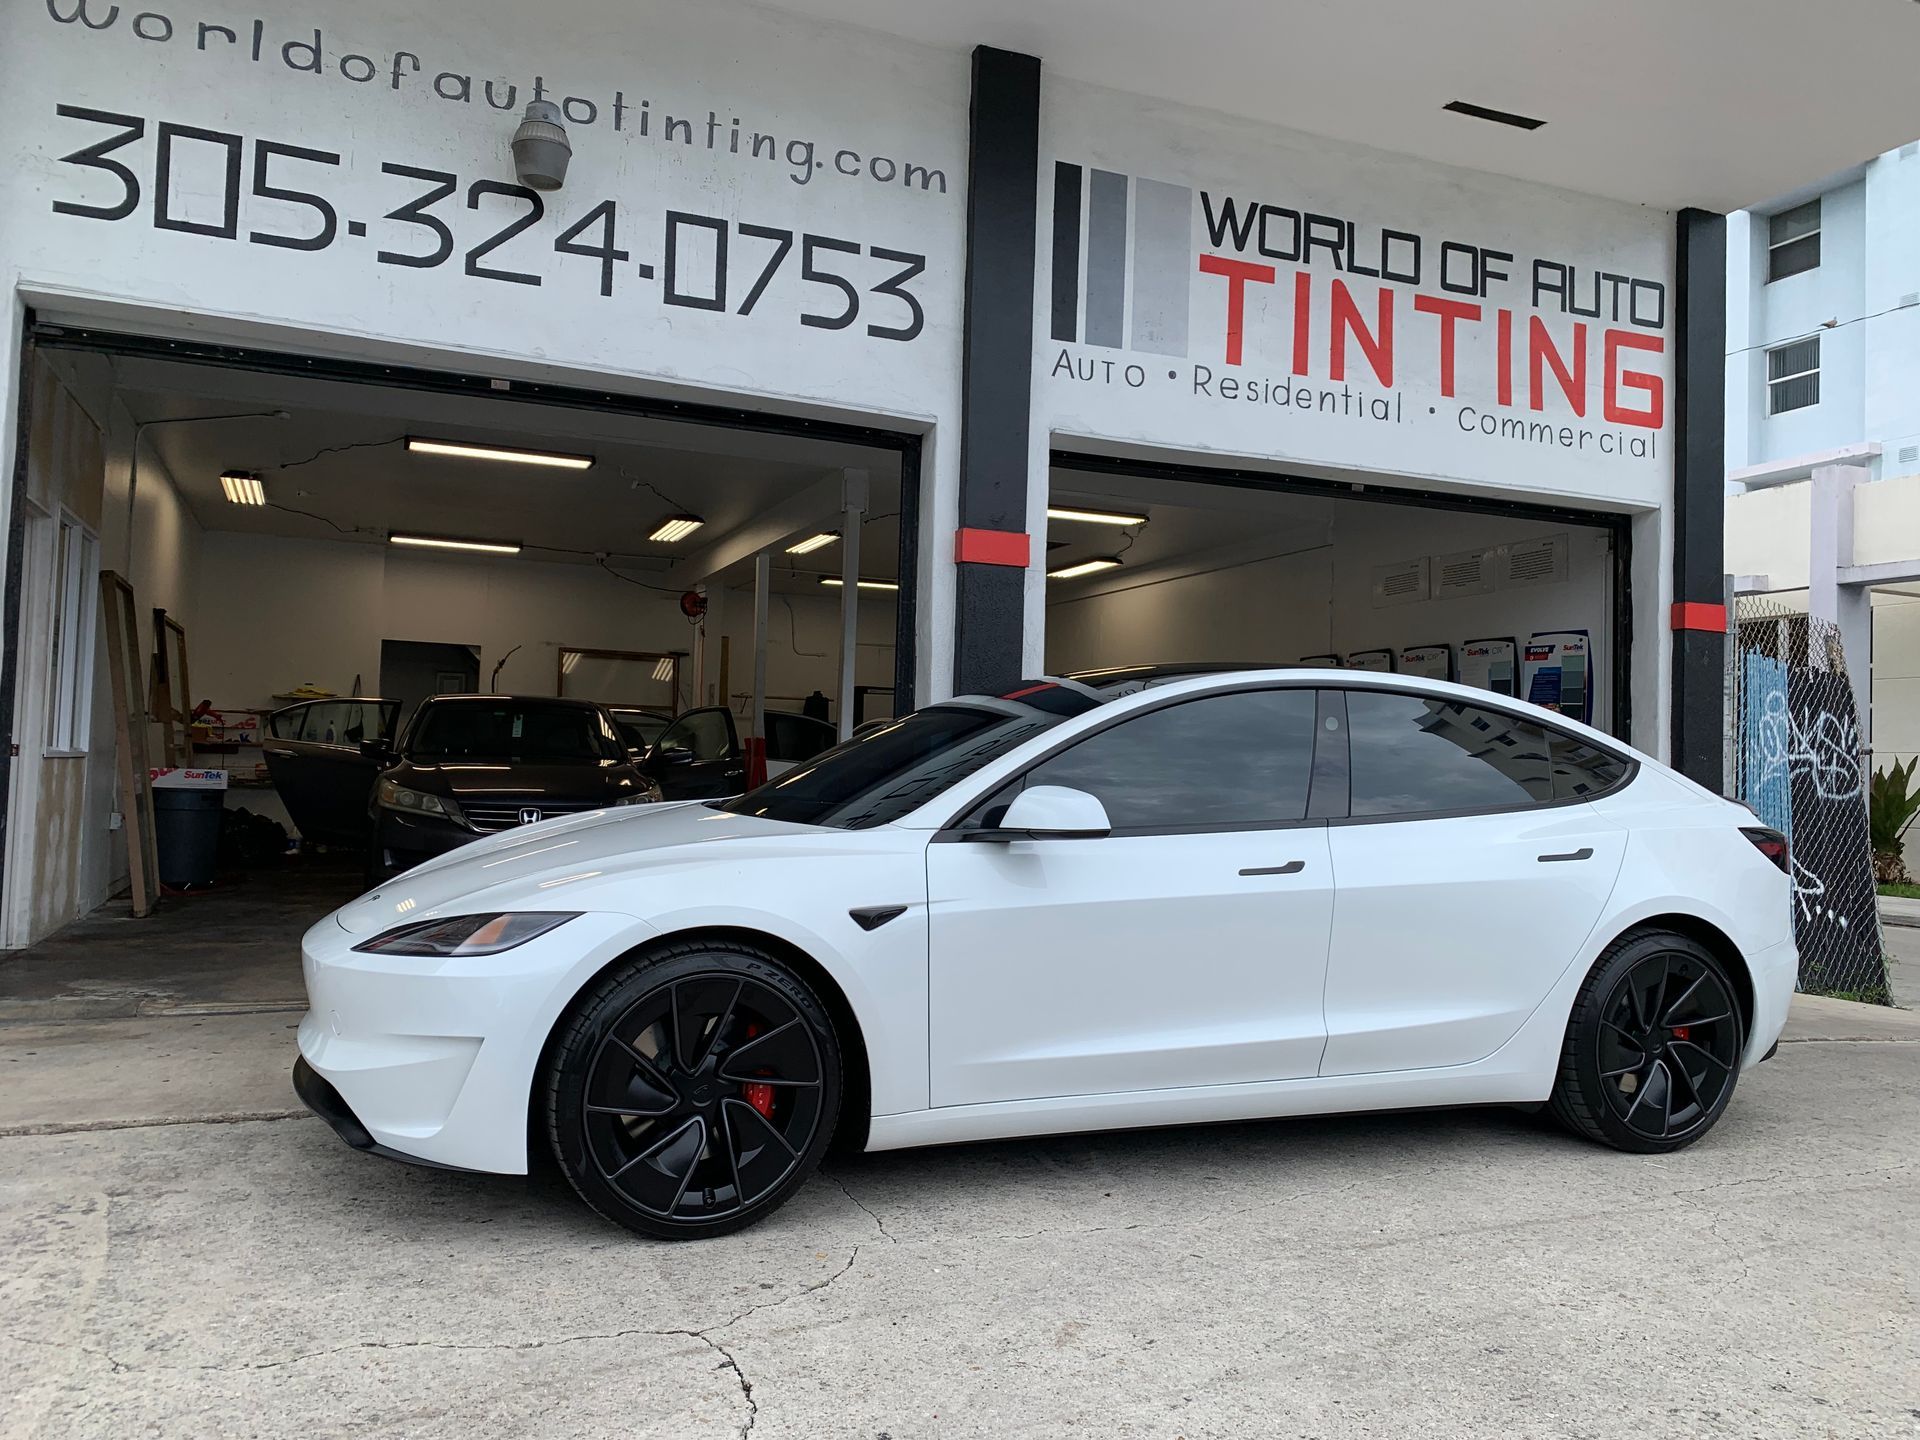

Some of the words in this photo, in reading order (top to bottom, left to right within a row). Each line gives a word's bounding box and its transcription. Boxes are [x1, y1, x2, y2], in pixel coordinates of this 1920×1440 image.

[1200, 190, 1422, 286] WORLD
[1440, 240, 1514, 298] OF
[1532, 258, 1665, 330] AUTO
[1199, 254, 1665, 430] TINTING
[1193, 364, 1402, 425] Residential
[1458, 406, 1658, 460] Commercial
[1405, 654, 1424, 663] SunTek
[1466, 647, 1489, 656] SunTek
[1562, 644, 1583, 652] SunTek
[184, 770, 223, 780] SunTek
[764, 969, 813, 1009] ZERO
